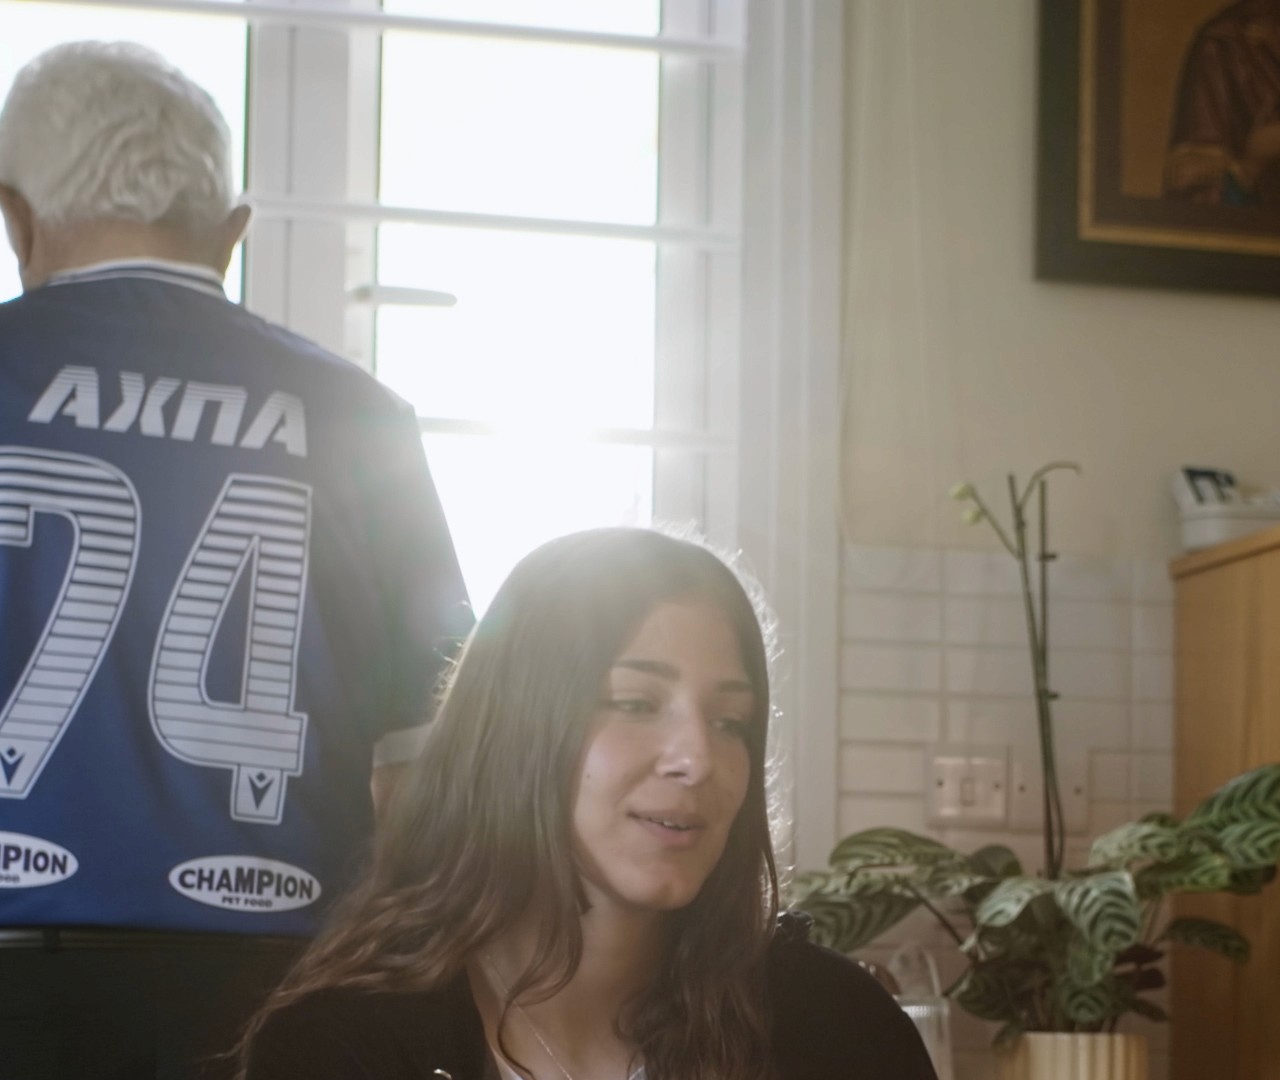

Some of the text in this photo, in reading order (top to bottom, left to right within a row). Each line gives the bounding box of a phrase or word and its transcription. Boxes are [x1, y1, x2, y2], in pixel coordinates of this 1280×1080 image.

[178, 866, 314, 900] CHAMPION
[221, 895, 273, 908] PET FOOD
